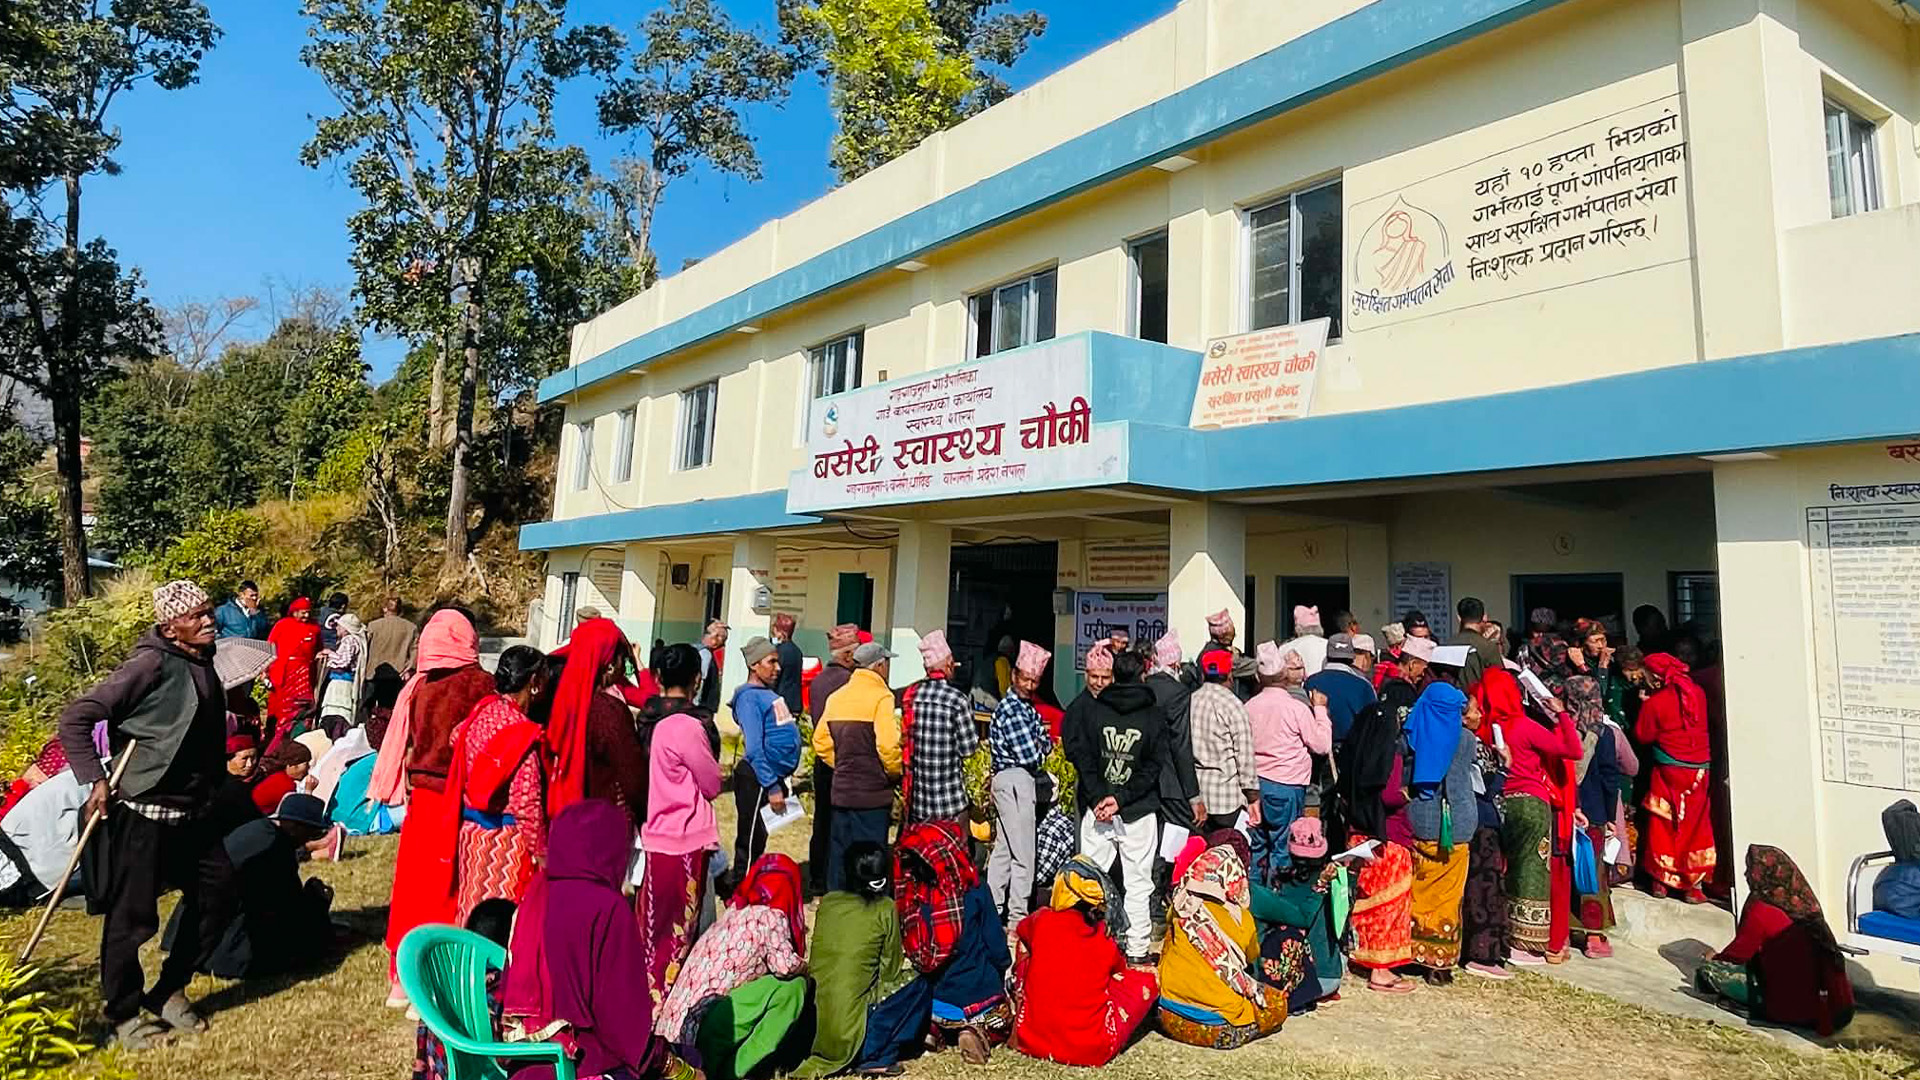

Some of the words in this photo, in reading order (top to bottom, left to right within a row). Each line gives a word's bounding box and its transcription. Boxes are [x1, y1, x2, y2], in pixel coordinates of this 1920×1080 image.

[1475, 167, 1511, 196] यहाँ
[1520, 162, 1543, 180] १०
[1547, 143, 1595, 174] हप्ता
[1605, 108, 1678, 151] भित्रको
[1465, 228, 1502, 253] साथ
[1504, 210, 1562, 244] सुरक्षित
[1562, 190, 1633, 221] गर्भपतन
[1635, 177, 1678, 206] सेवा
[1539, 234, 1585, 262] प्रदान
[1019, 396, 1091, 449] चौकी
